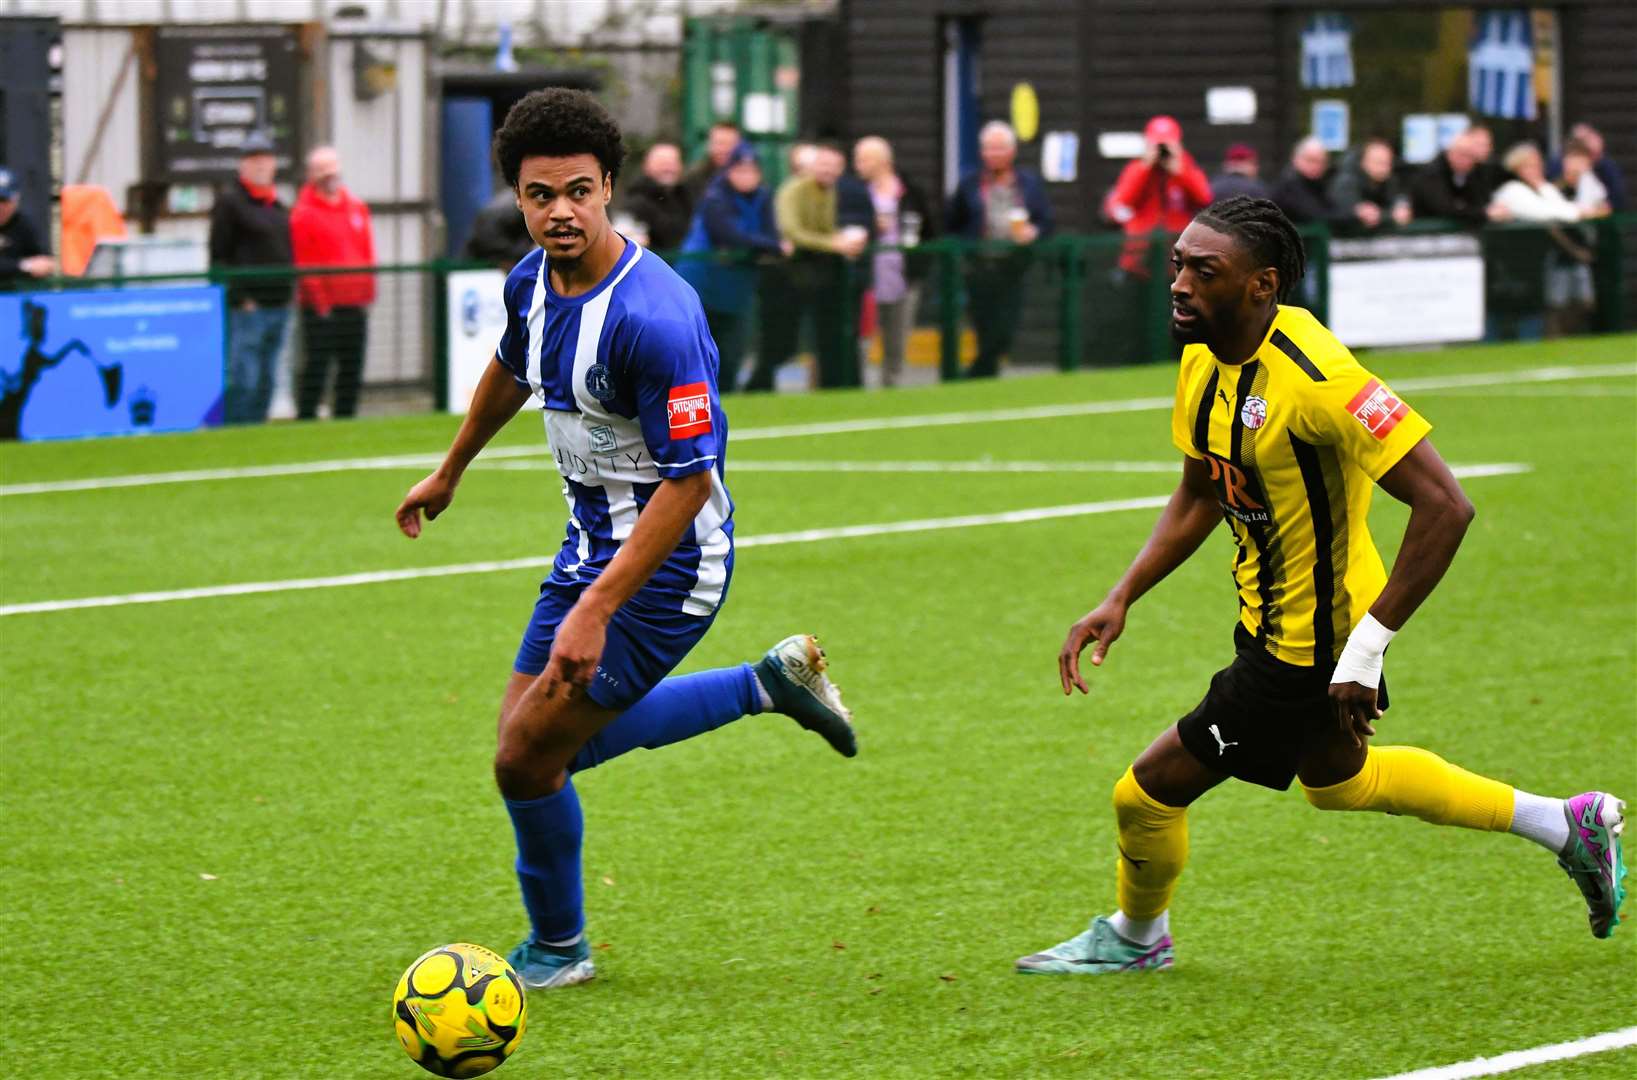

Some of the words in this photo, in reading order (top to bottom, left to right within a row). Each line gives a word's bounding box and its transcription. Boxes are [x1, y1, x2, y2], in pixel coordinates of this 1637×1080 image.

[673, 397, 705, 415] PITCHING
[688, 409, 697, 422] IN
[1251, 511, 1268, 521] Ltd
